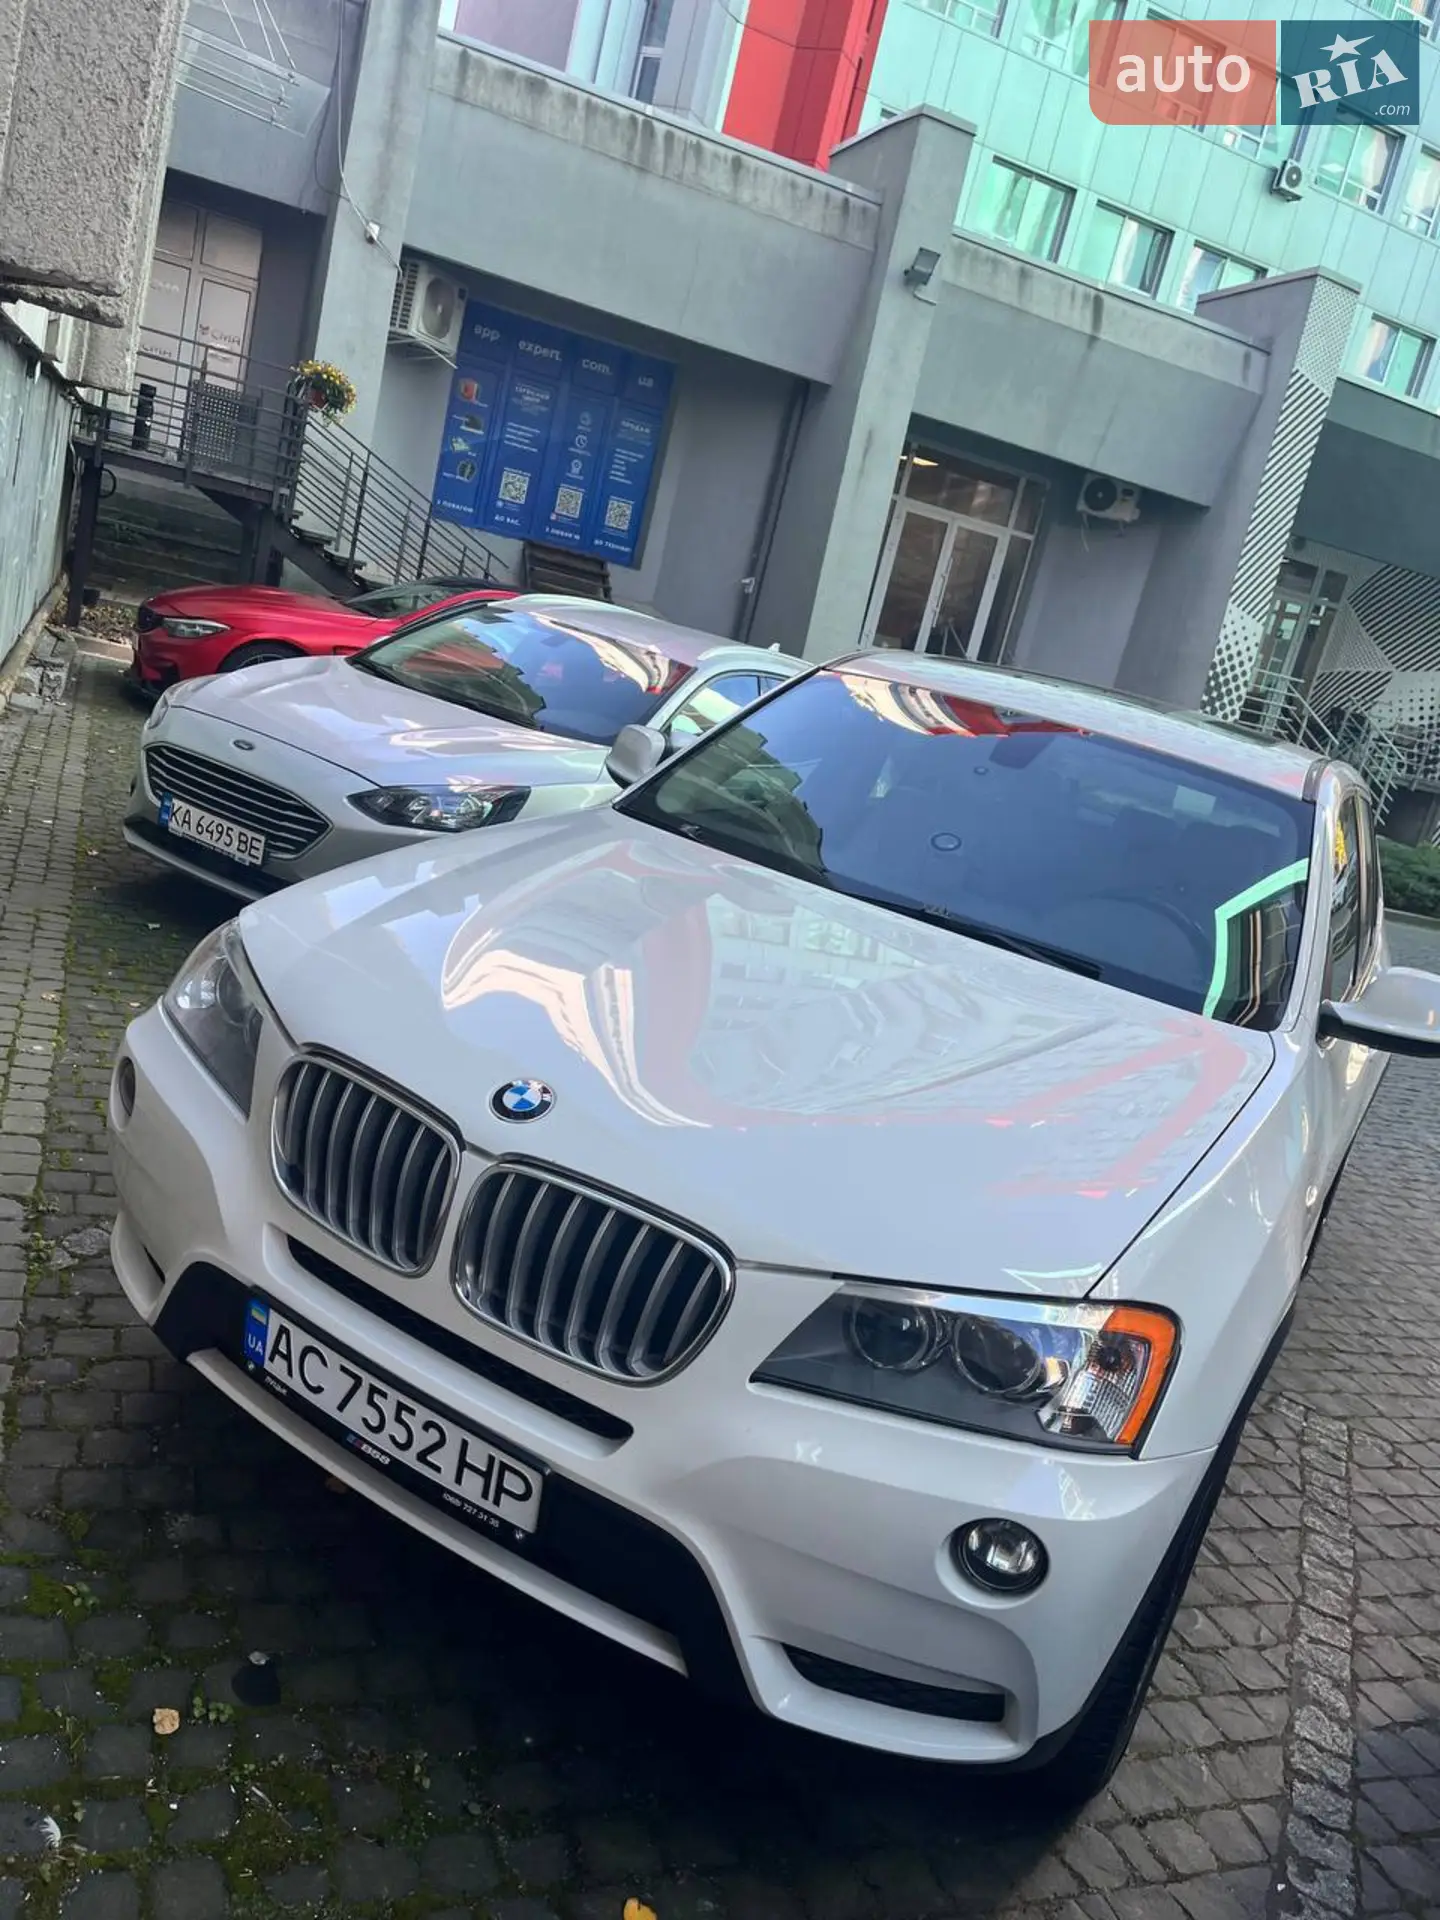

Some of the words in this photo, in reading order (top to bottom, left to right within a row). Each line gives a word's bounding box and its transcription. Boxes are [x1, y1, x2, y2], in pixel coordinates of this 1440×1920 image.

[169, 803, 192, 831] KA
[196, 816, 234, 847] 6495
[236, 830, 262, 860] BE
[247, 1335, 265, 1357] UA
[268, 1323, 329, 1395] AC
[337, 1365, 448, 1475] 7552
[454, 1437, 533, 1508] HP
